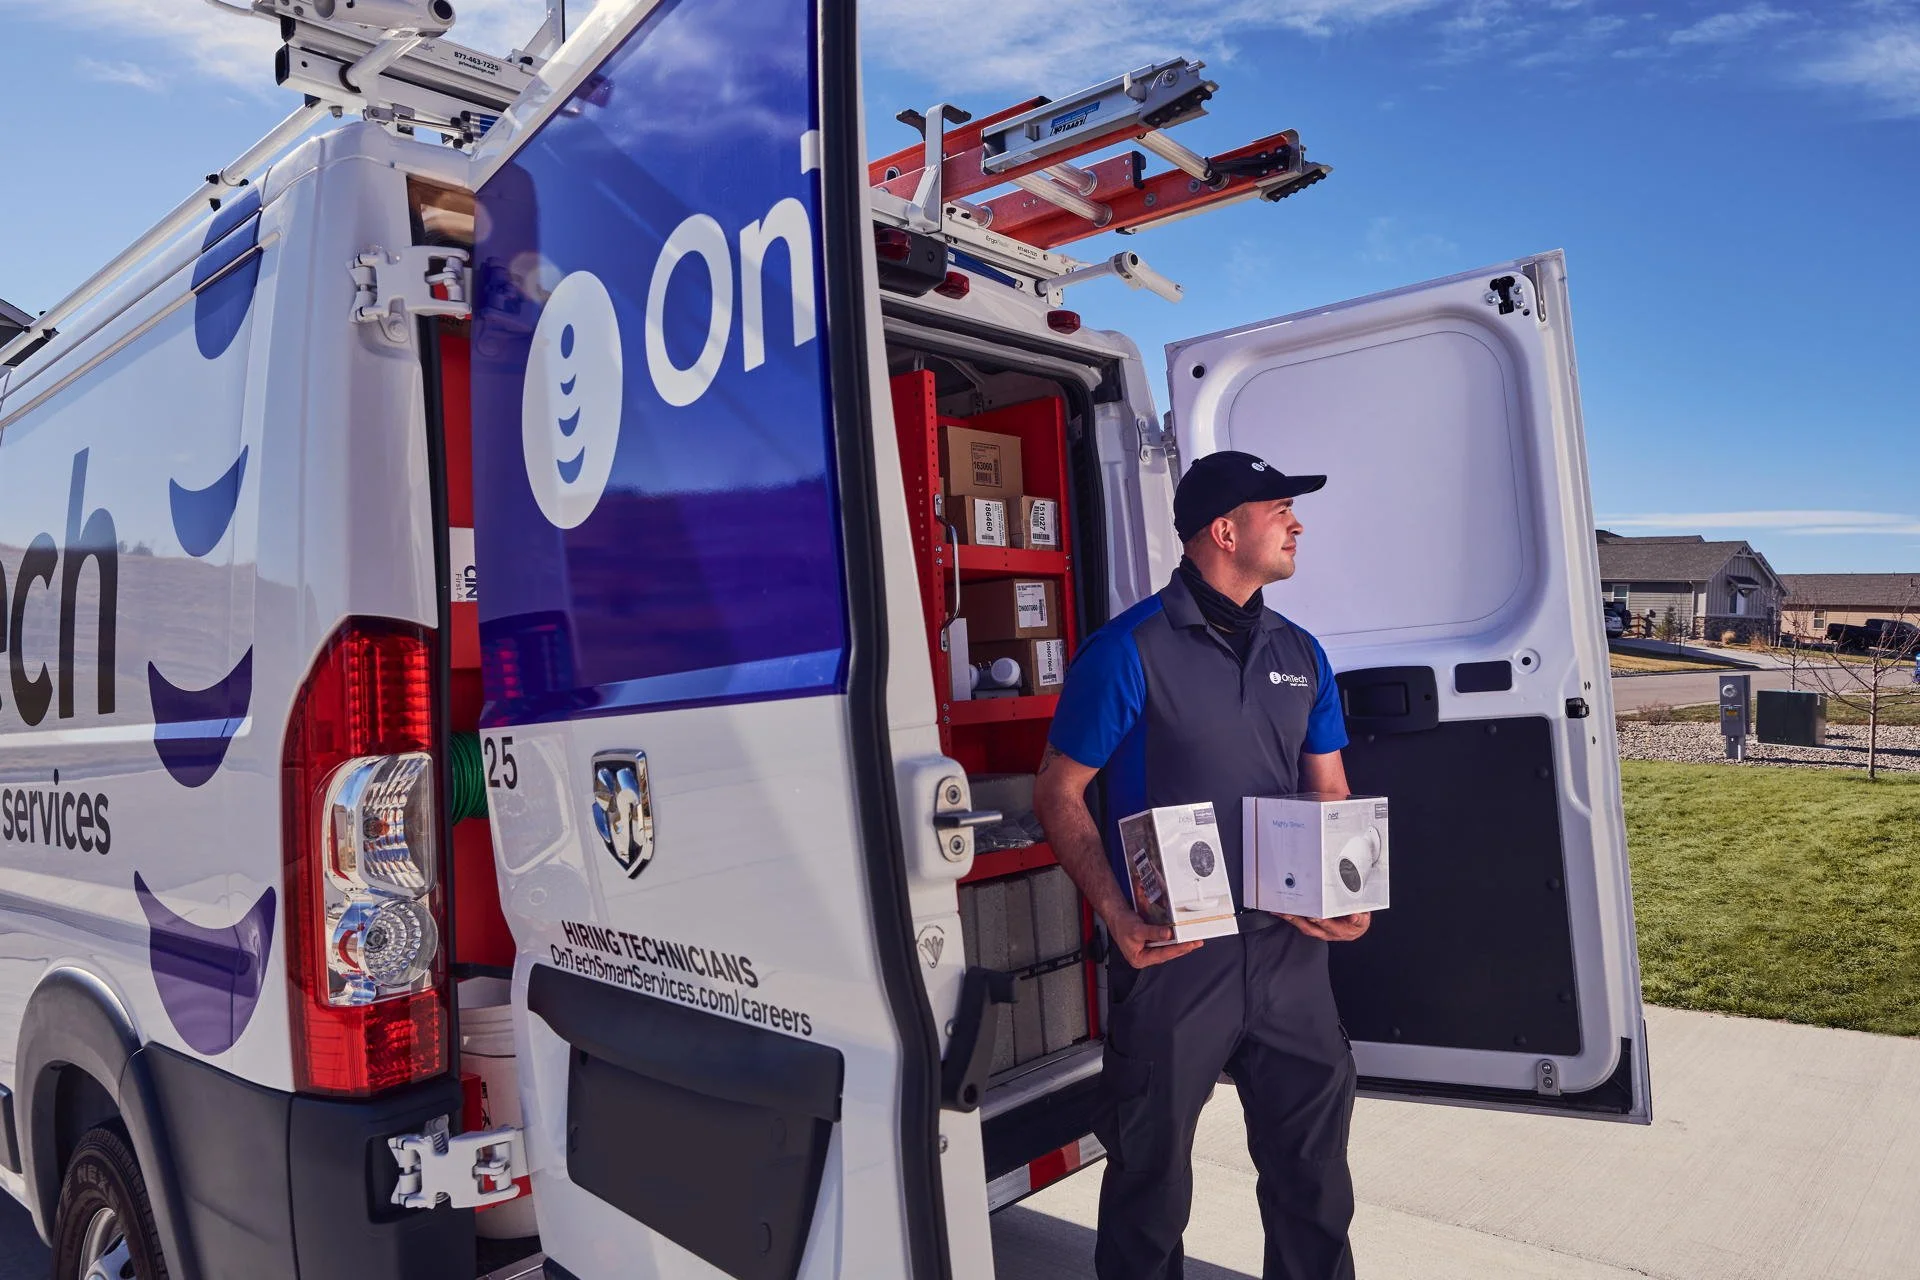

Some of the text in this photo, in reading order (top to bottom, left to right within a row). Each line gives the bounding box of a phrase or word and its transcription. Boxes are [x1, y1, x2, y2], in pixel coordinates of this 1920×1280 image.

[454, 51, 499, 71] 877-463-7225
[984, 502, 993, 532] 186460
[0, 446, 118, 727] ch
[1281, 673, 1308, 684] OnTech
[484, 736, 518, 790] 25
[2, 768, 111, 855] services
[561, 919, 759, 989] HIRING TECHNICIANS
[550, 944, 813, 1037] OnTechSmartServices.com/careers
